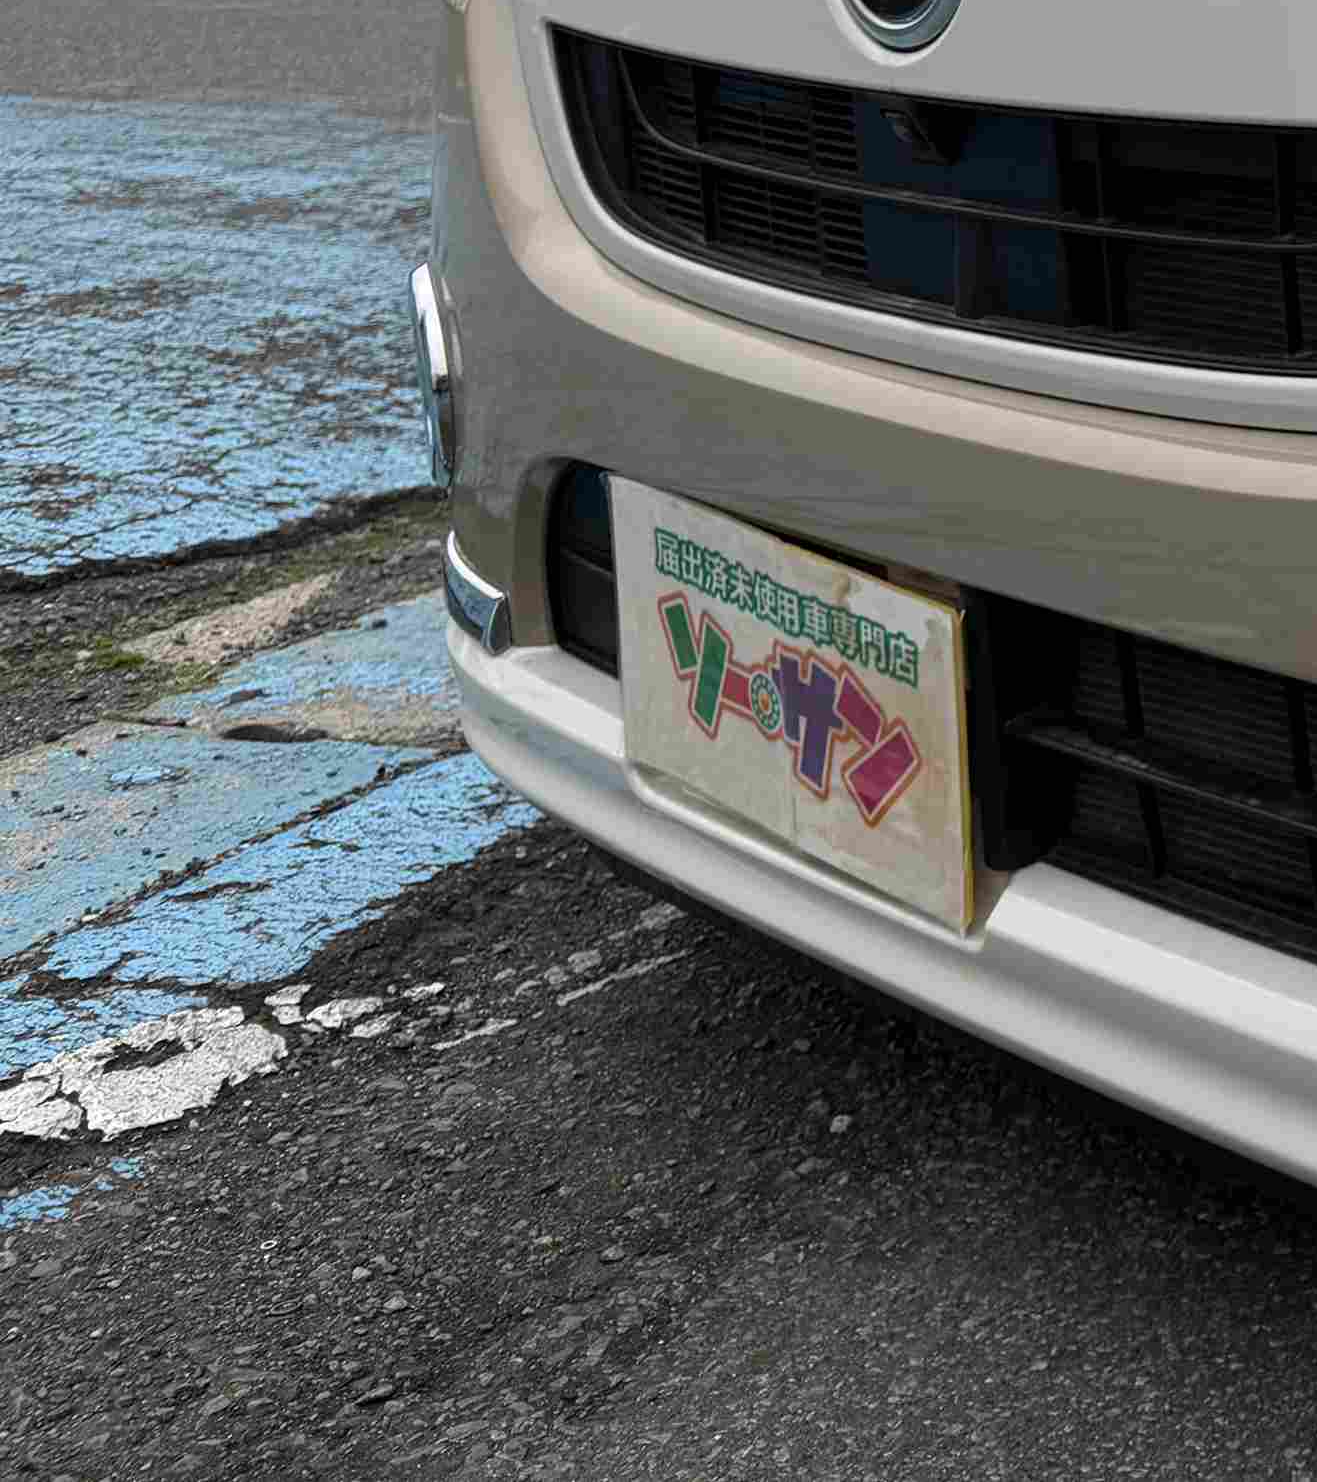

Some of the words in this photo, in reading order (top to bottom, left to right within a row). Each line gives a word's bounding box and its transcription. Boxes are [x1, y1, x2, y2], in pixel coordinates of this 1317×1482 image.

[655, 527, 919, 687] 届出済未使用車専門店
[657, 591, 921, 829] ソーサン
